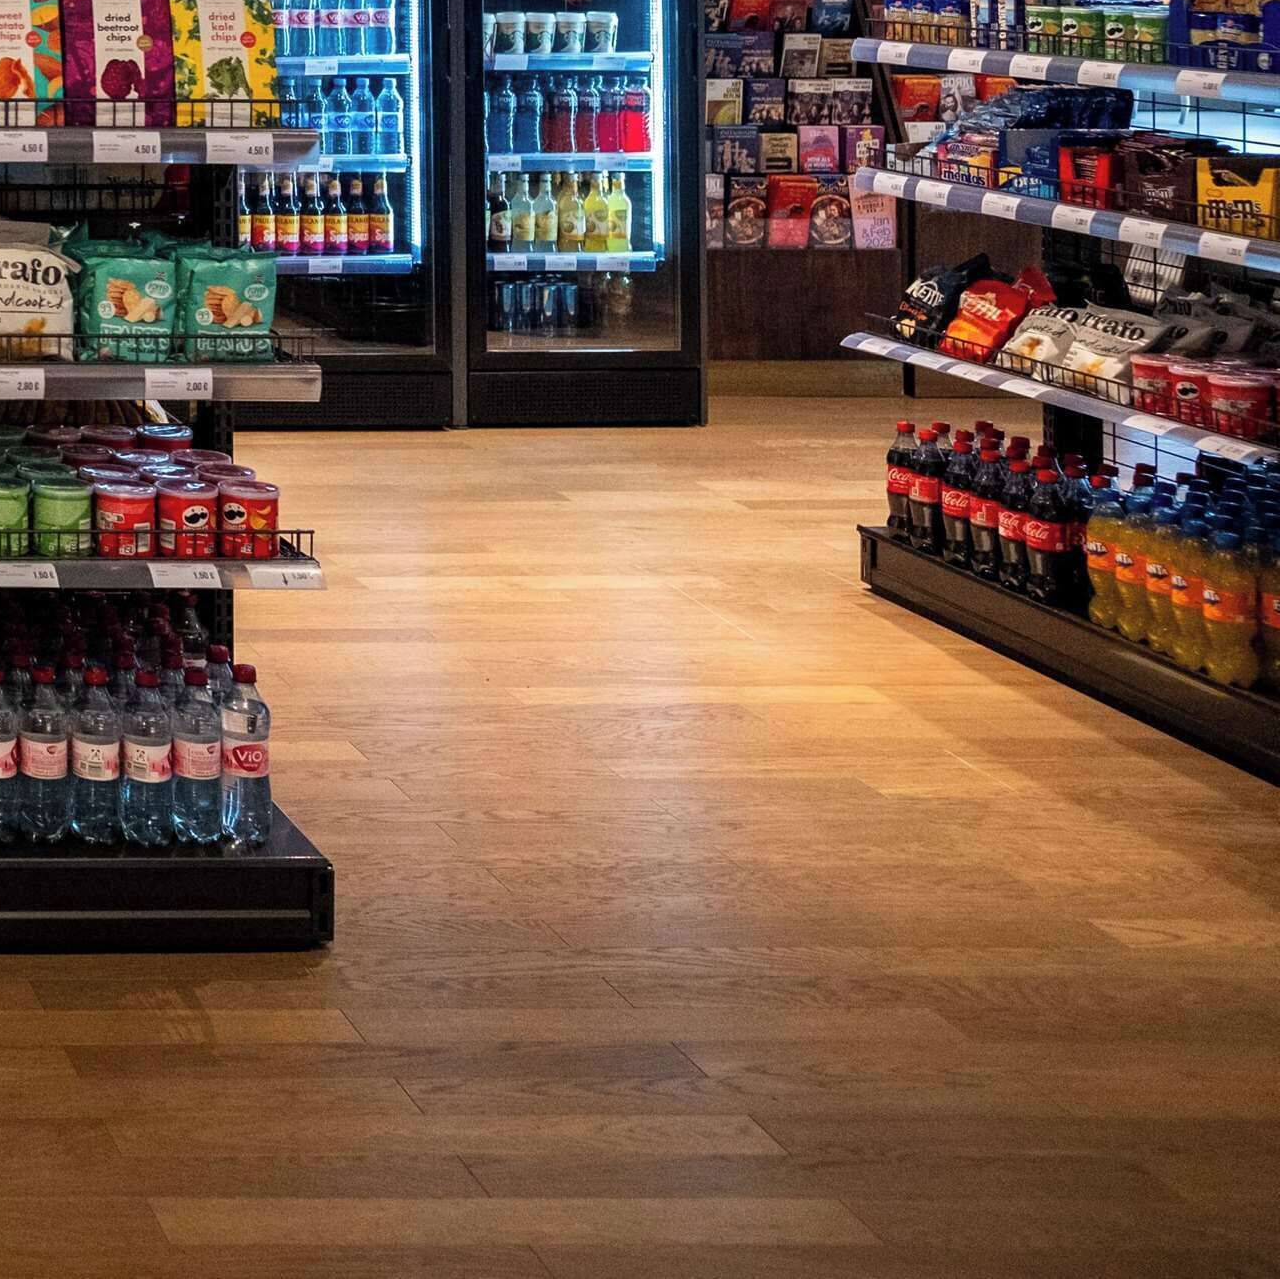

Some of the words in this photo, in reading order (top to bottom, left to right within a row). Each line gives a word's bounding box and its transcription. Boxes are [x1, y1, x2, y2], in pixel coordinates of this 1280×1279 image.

[105, 13, 131, 22] dried
[208, 12, 235, 22] dried
[97, 23, 139, 32] beetroot
[106, 33, 131, 42] chips
[210, 32, 237, 43] chips
[943, 169, 986, 186] mentos
